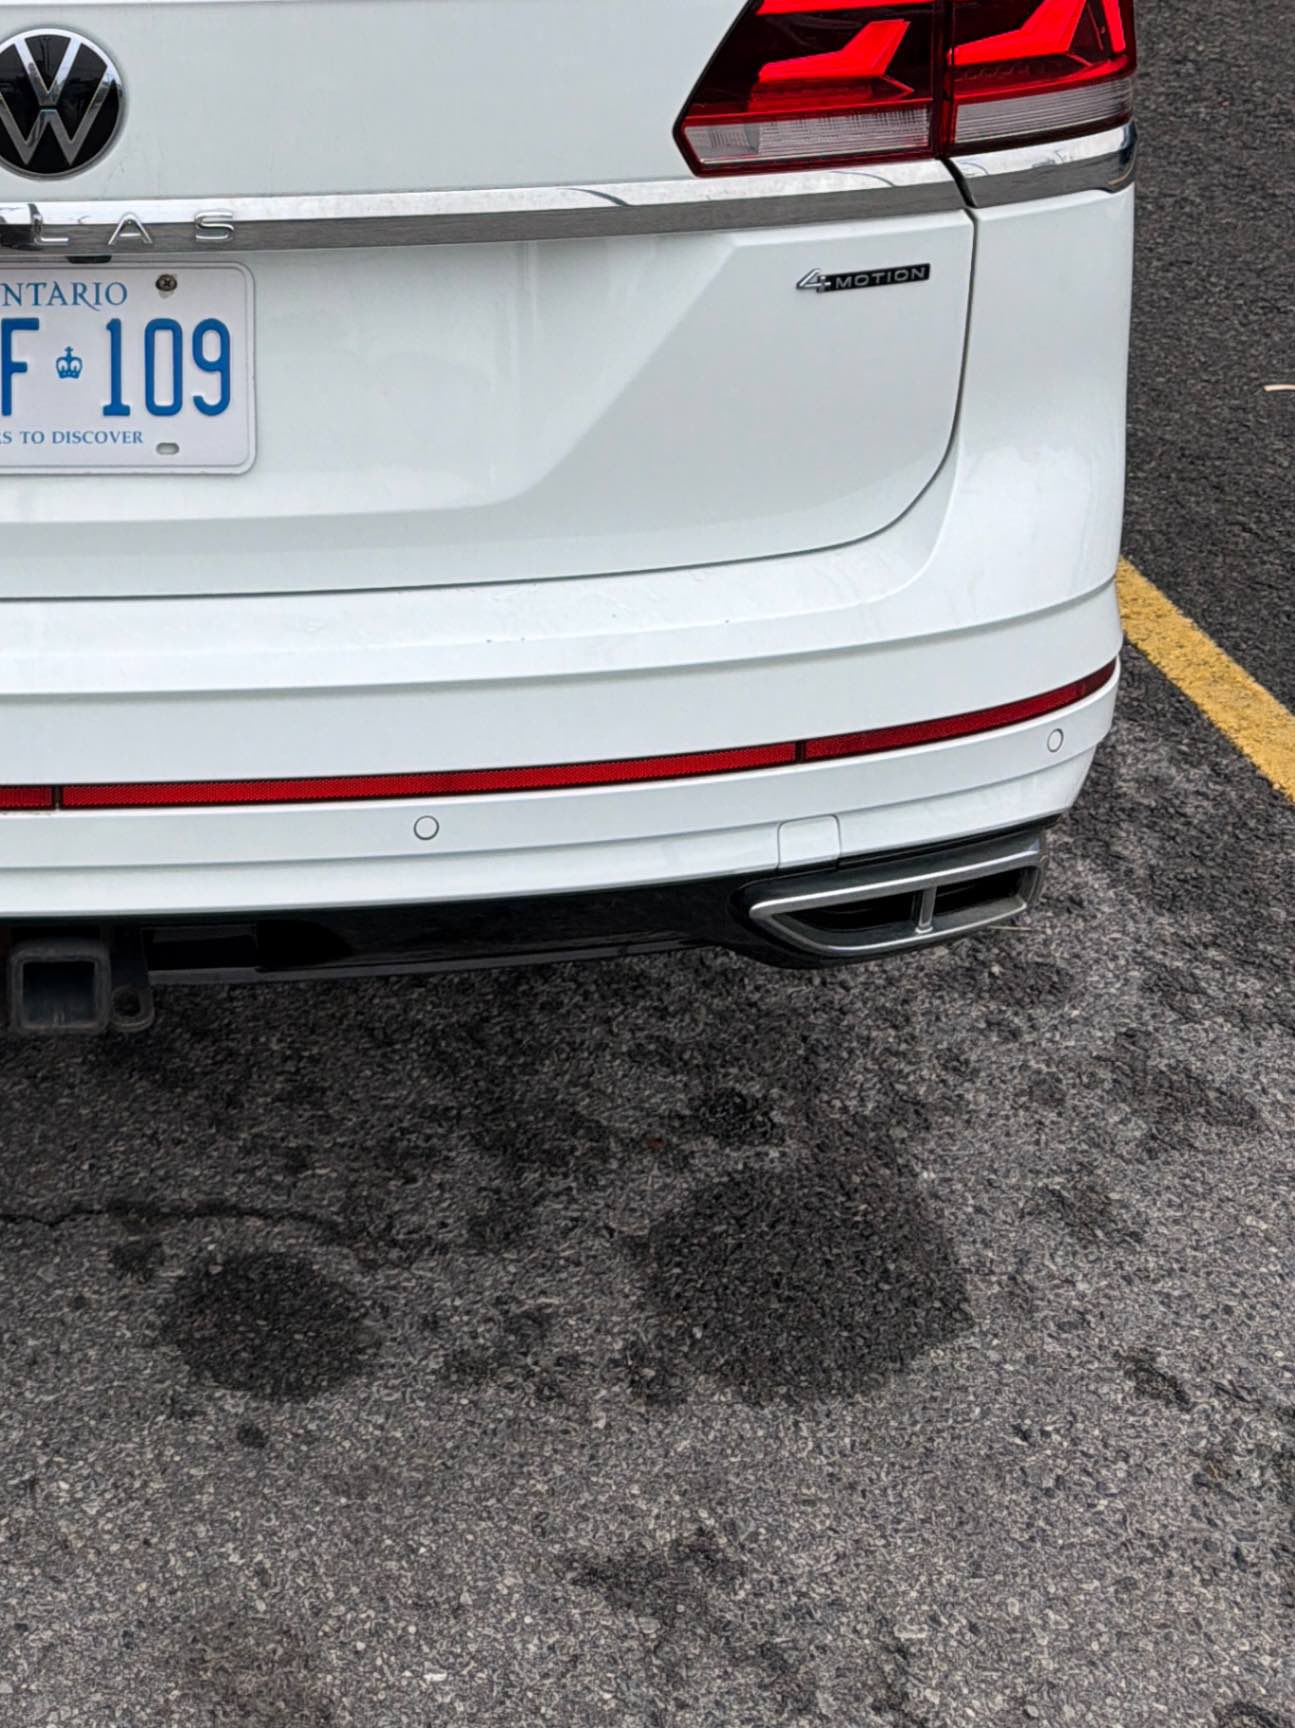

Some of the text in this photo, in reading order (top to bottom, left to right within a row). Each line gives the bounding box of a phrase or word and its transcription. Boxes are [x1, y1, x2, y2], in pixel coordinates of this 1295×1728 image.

[102, 317, 230, 417] 109
[19, 431, 45, 445] TO
[52, 430, 144, 445] DISCOVER
